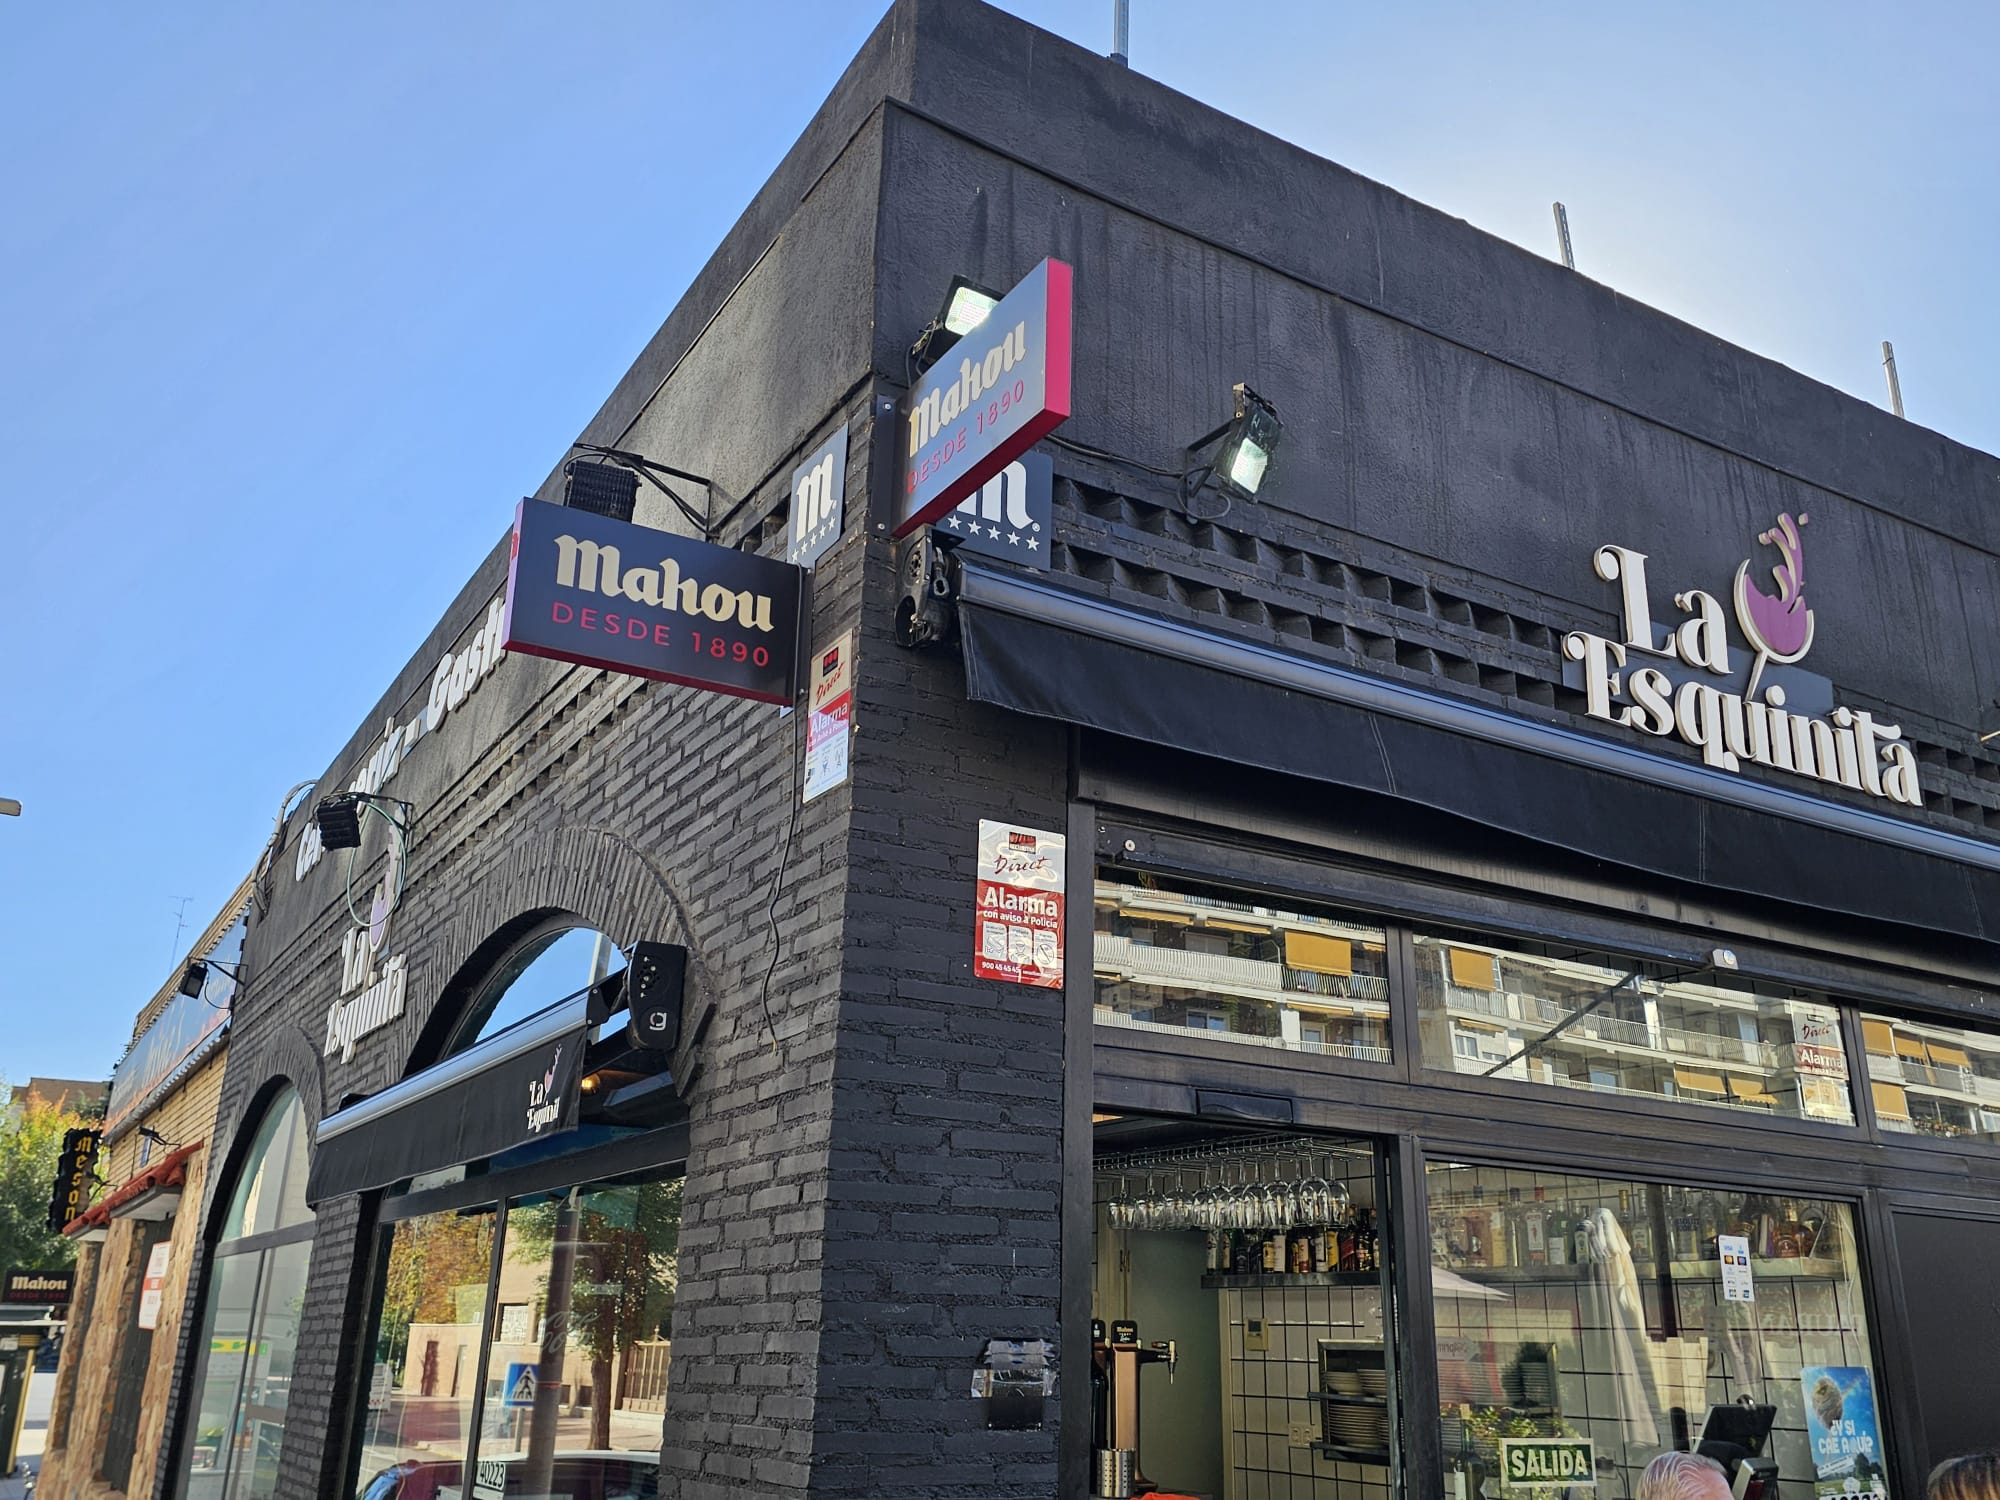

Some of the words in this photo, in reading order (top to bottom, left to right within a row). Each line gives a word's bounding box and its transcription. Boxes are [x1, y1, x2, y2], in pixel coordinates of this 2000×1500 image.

[908, 426, 967, 494] DESDE
[976, 379, 1024, 434] 1890
[1594, 544, 1734, 675] La
[552, 601, 671, 646] DESDE
[691, 631, 769, 667] 1890
[810, 702, 848, 738] Alarma
[1563, 630, 1923, 807] Esquinita
[994, 855, 1051, 875] Direct
[983, 886, 1058, 918] Alarma
[1000, 911, 1022, 923] aviso
[1801, 1049, 1844, 1070] Alarma
[479, 1460, 505, 1488] 40223
[1511, 1448, 1588, 1478] SALIDA
